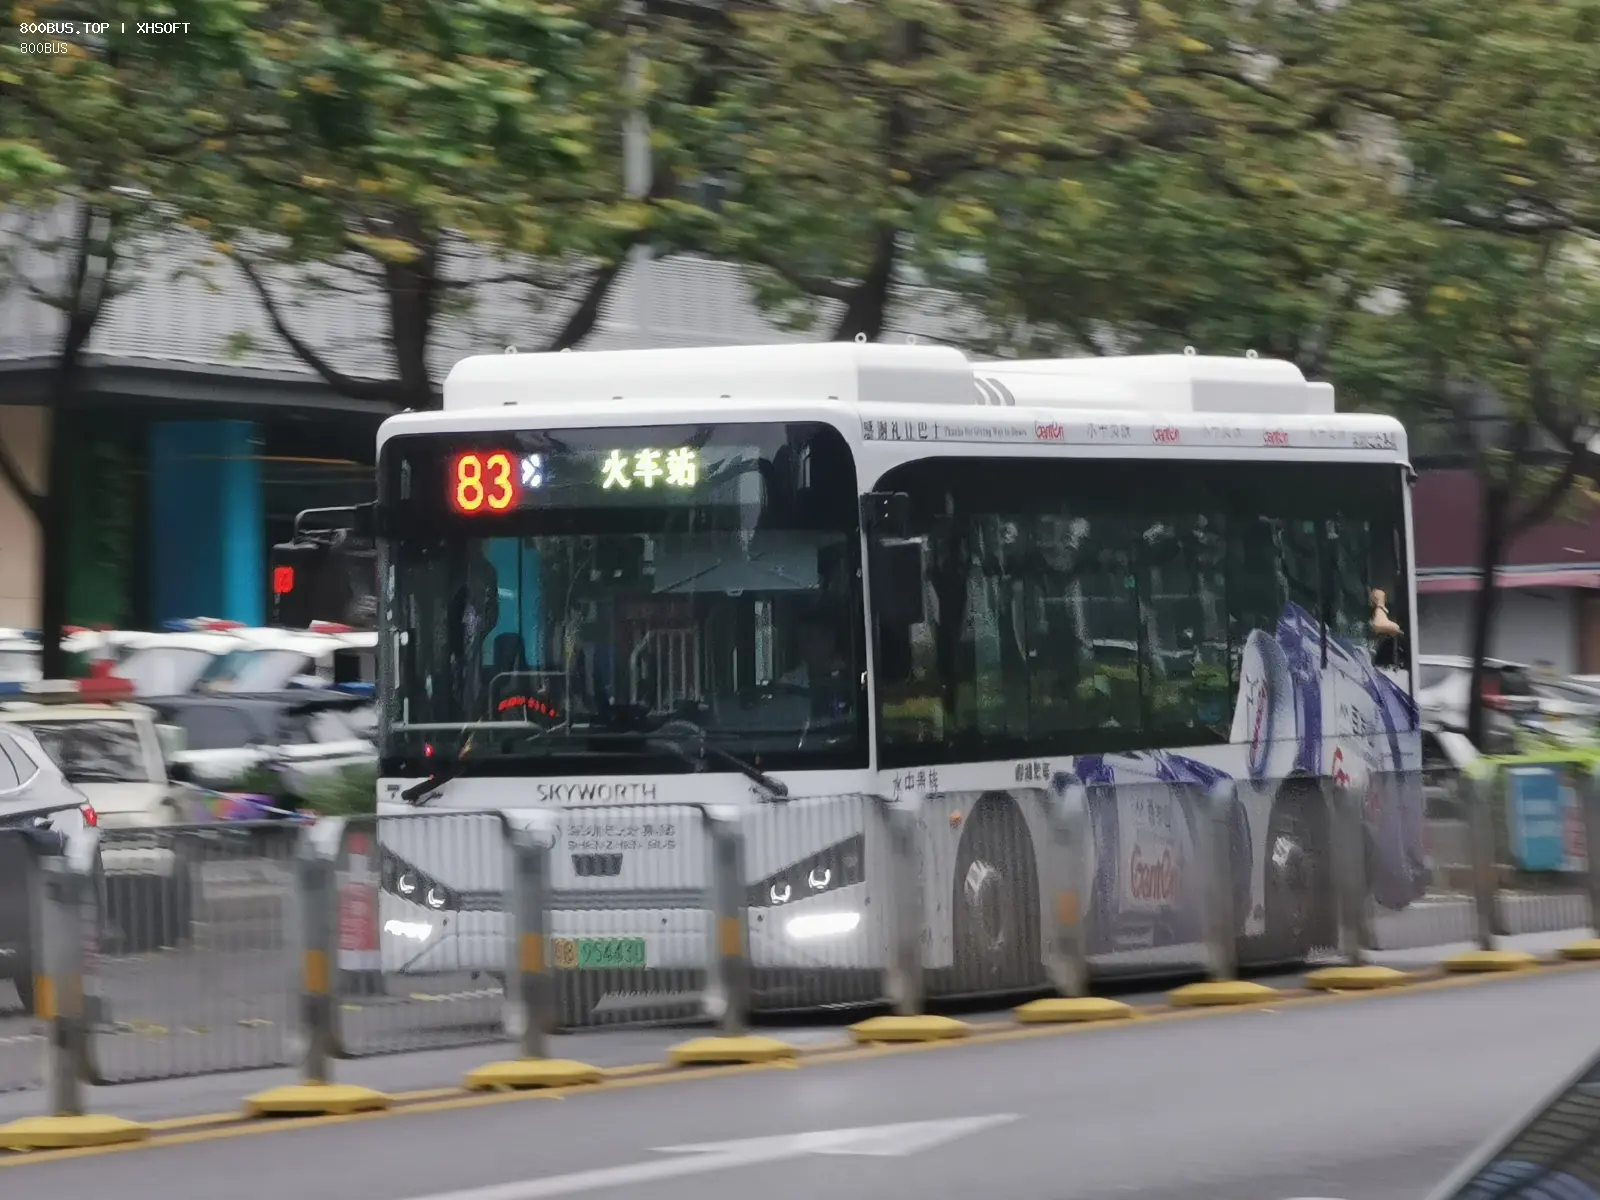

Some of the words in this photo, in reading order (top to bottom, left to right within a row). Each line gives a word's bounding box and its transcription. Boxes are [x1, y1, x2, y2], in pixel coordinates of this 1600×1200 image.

[456, 453, 513, 511] 83
[602, 447, 697, 489] 火车站
[536, 783, 657, 802] SKYWORTH
